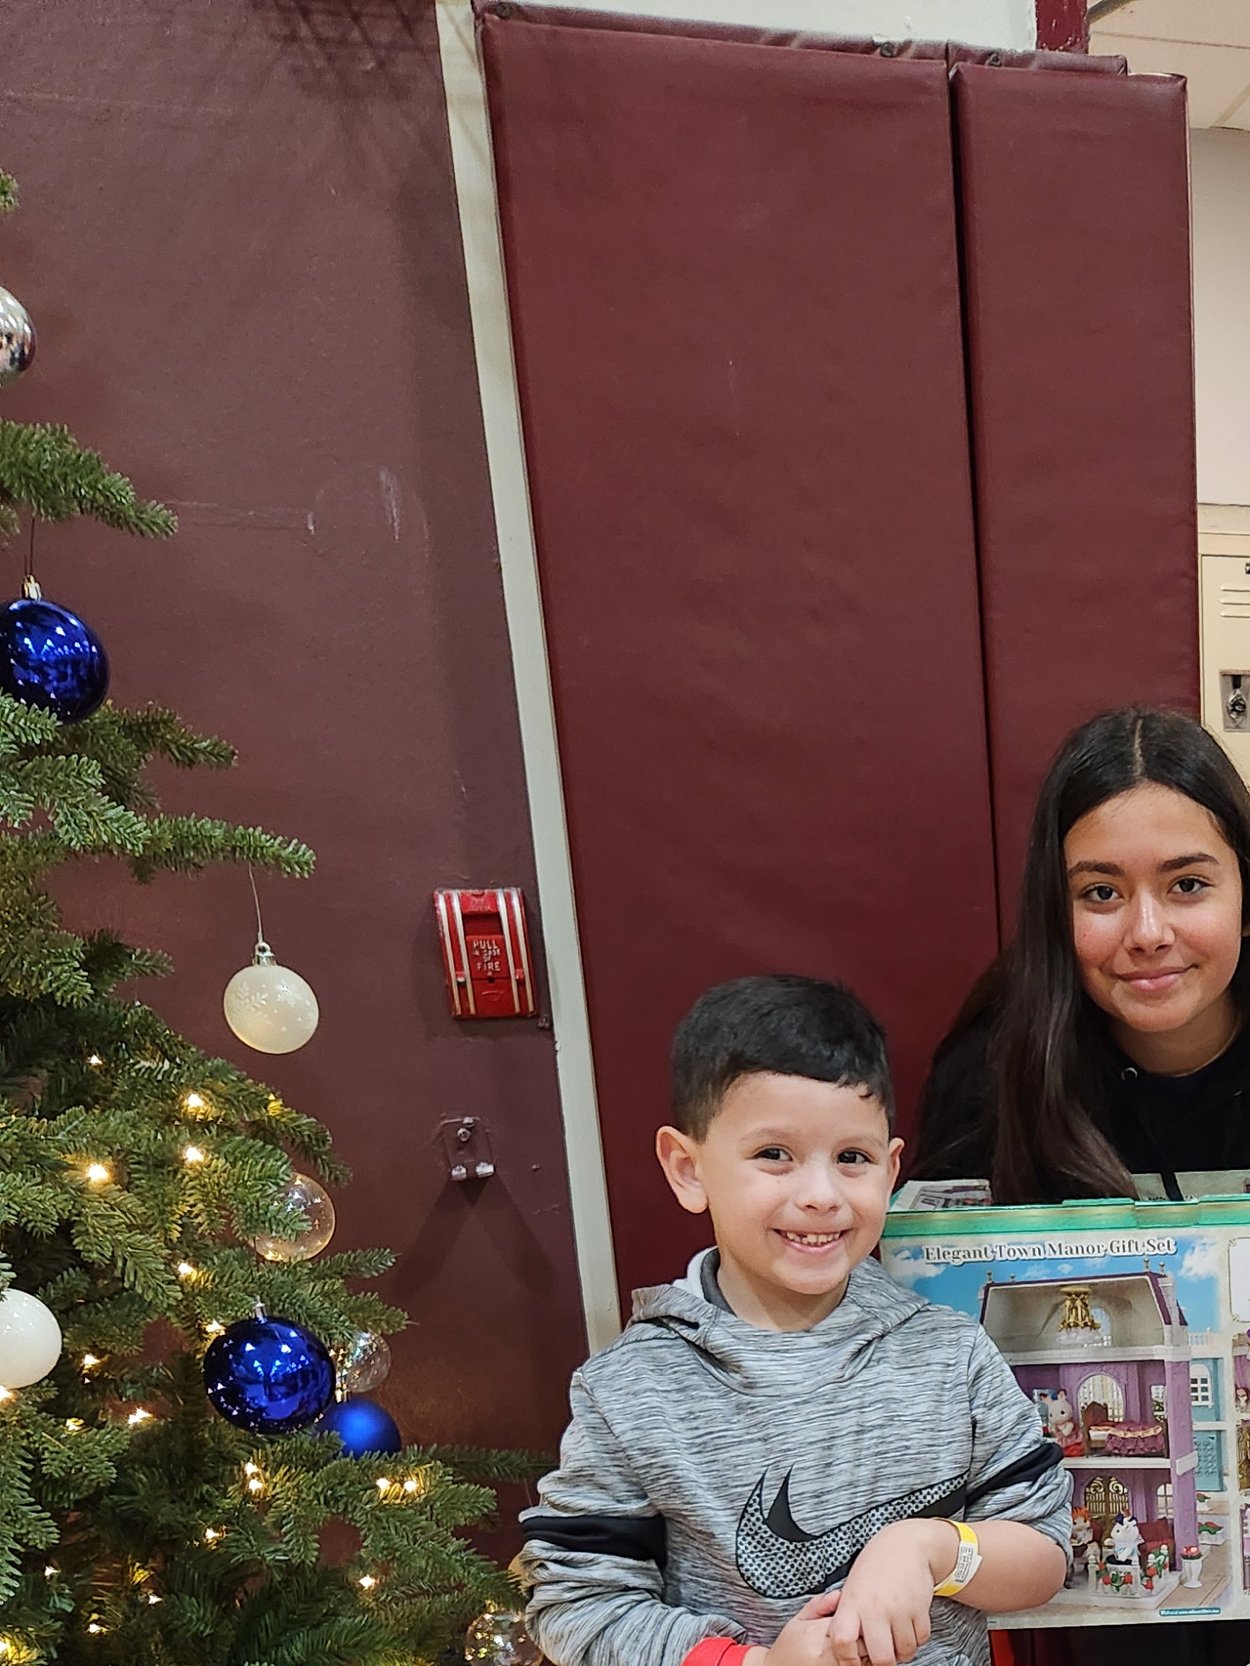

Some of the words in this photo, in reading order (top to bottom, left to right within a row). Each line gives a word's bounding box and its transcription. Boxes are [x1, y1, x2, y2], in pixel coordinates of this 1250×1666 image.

[473, 940, 498, 950] PULL
[476, 961, 500, 972] FIRE
[925, 1246, 990, 1263] Elegant
[994, 1244, 1042, 1259] Town
[1047, 1242, 1104, 1256] Manor
[1109, 1239, 1140, 1254] Gift
[1146, 1238, 1173, 1252] Set
